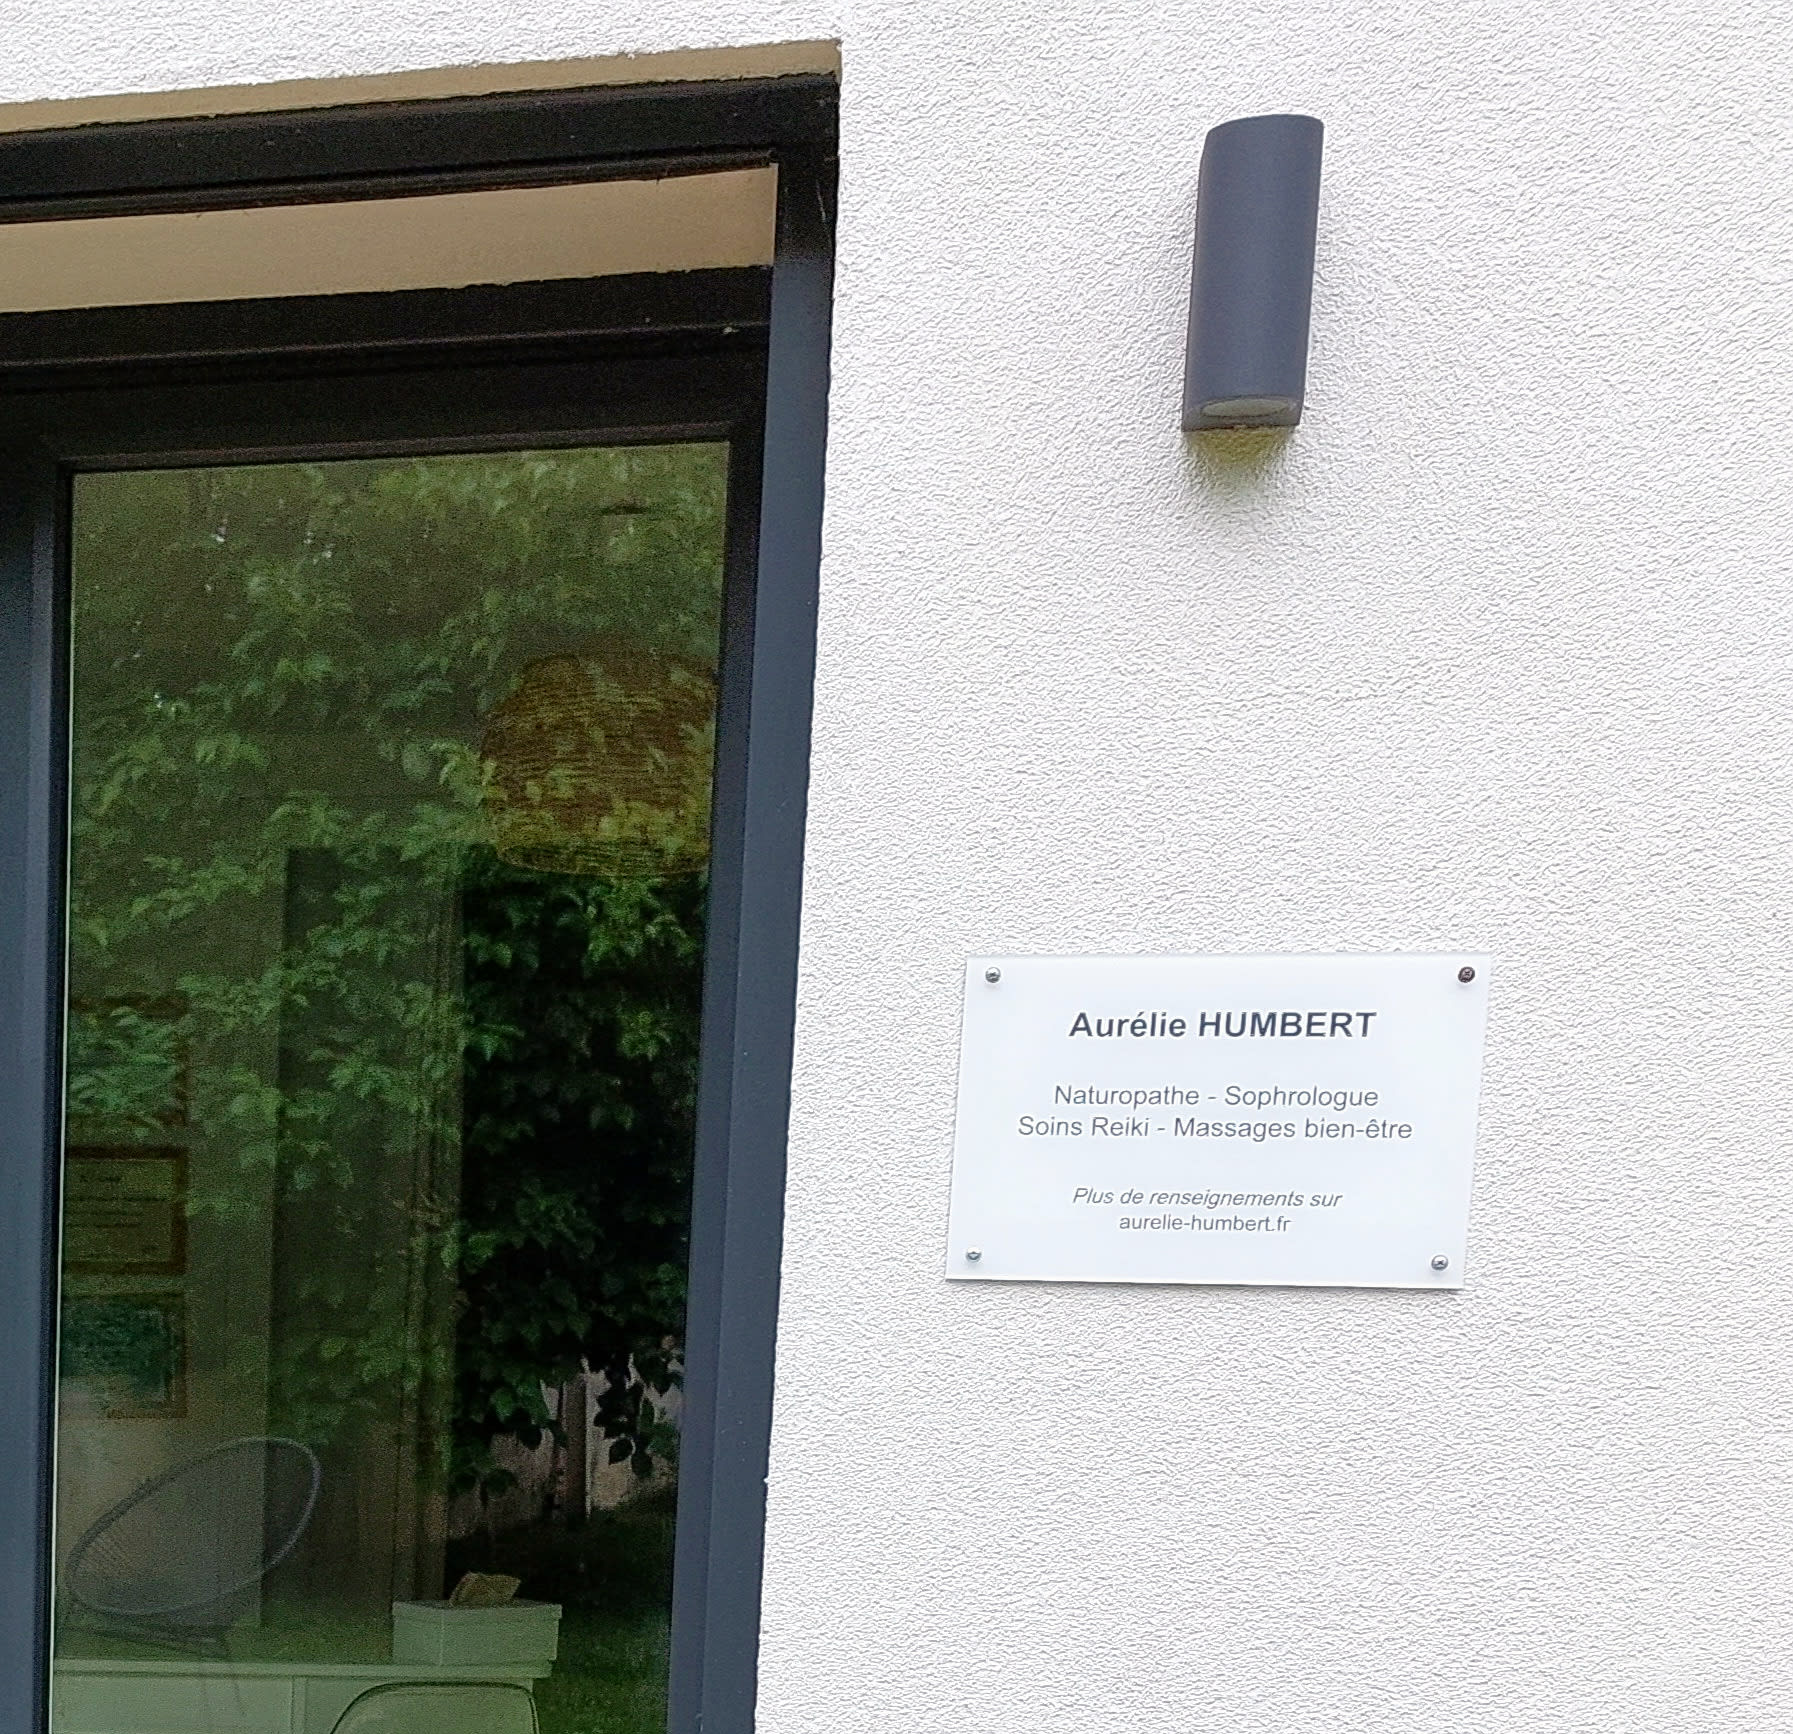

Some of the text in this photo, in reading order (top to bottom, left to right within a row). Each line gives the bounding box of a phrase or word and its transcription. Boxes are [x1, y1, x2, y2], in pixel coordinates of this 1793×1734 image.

[1069, 1010, 1378, 1038] Aurélie HUMBERT
[1054, 1085, 1200, 1111] Naturopathe
[1224, 1085, 1379, 1112] Sophrologue
[1018, 1115, 1083, 1137] Soins
[1091, 1116, 1150, 1137] Reiki
[1174, 1117, 1296, 1143] Massages
[1304, 1117, 1413, 1139] bien-être
[1072, 1187, 1344, 1210] Plus de renseignements sur
[1119, 1213, 1292, 1233] aurelie-humbert.fr
